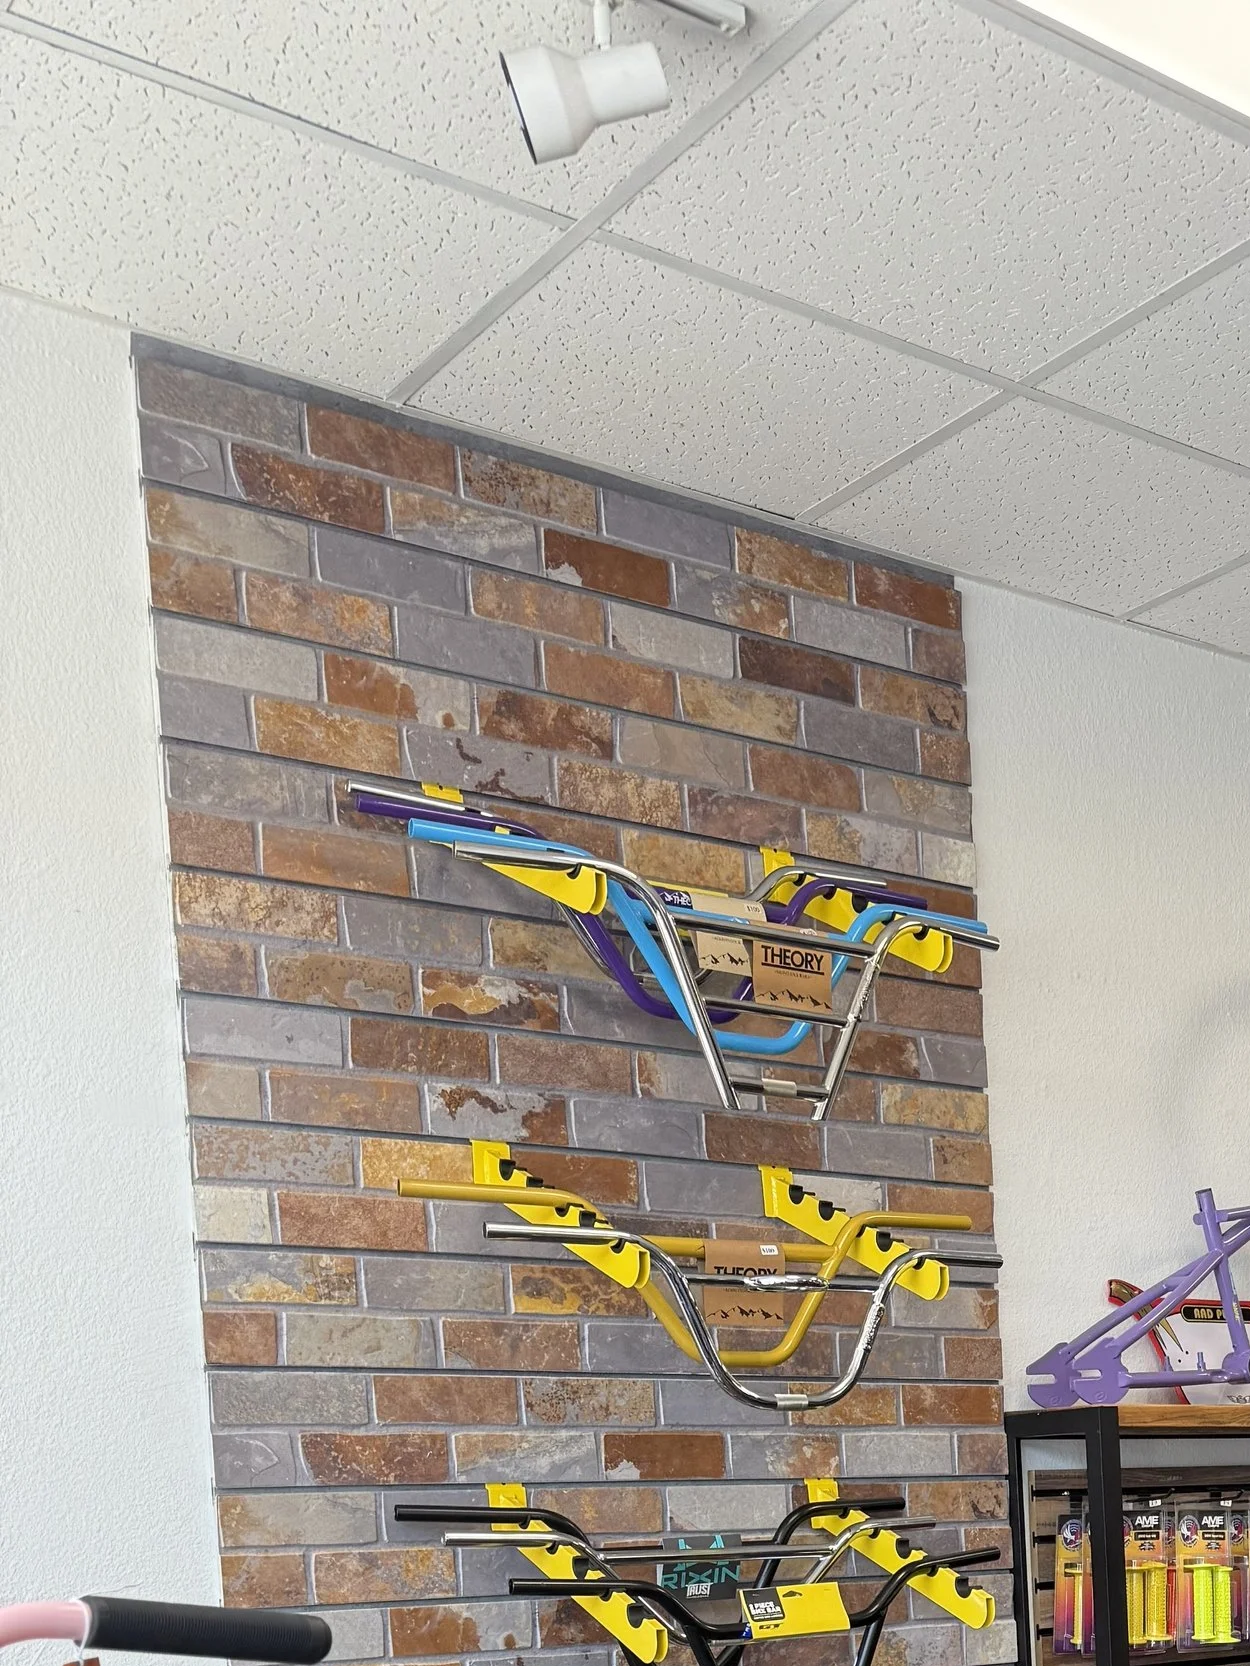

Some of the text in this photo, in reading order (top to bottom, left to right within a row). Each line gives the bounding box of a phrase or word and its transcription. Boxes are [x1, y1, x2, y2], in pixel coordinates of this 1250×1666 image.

[761, 944, 824, 972] THEORY
[1135, 1516, 1159, 1526] AME
[1202, 1515, 1224, 1526] AME
